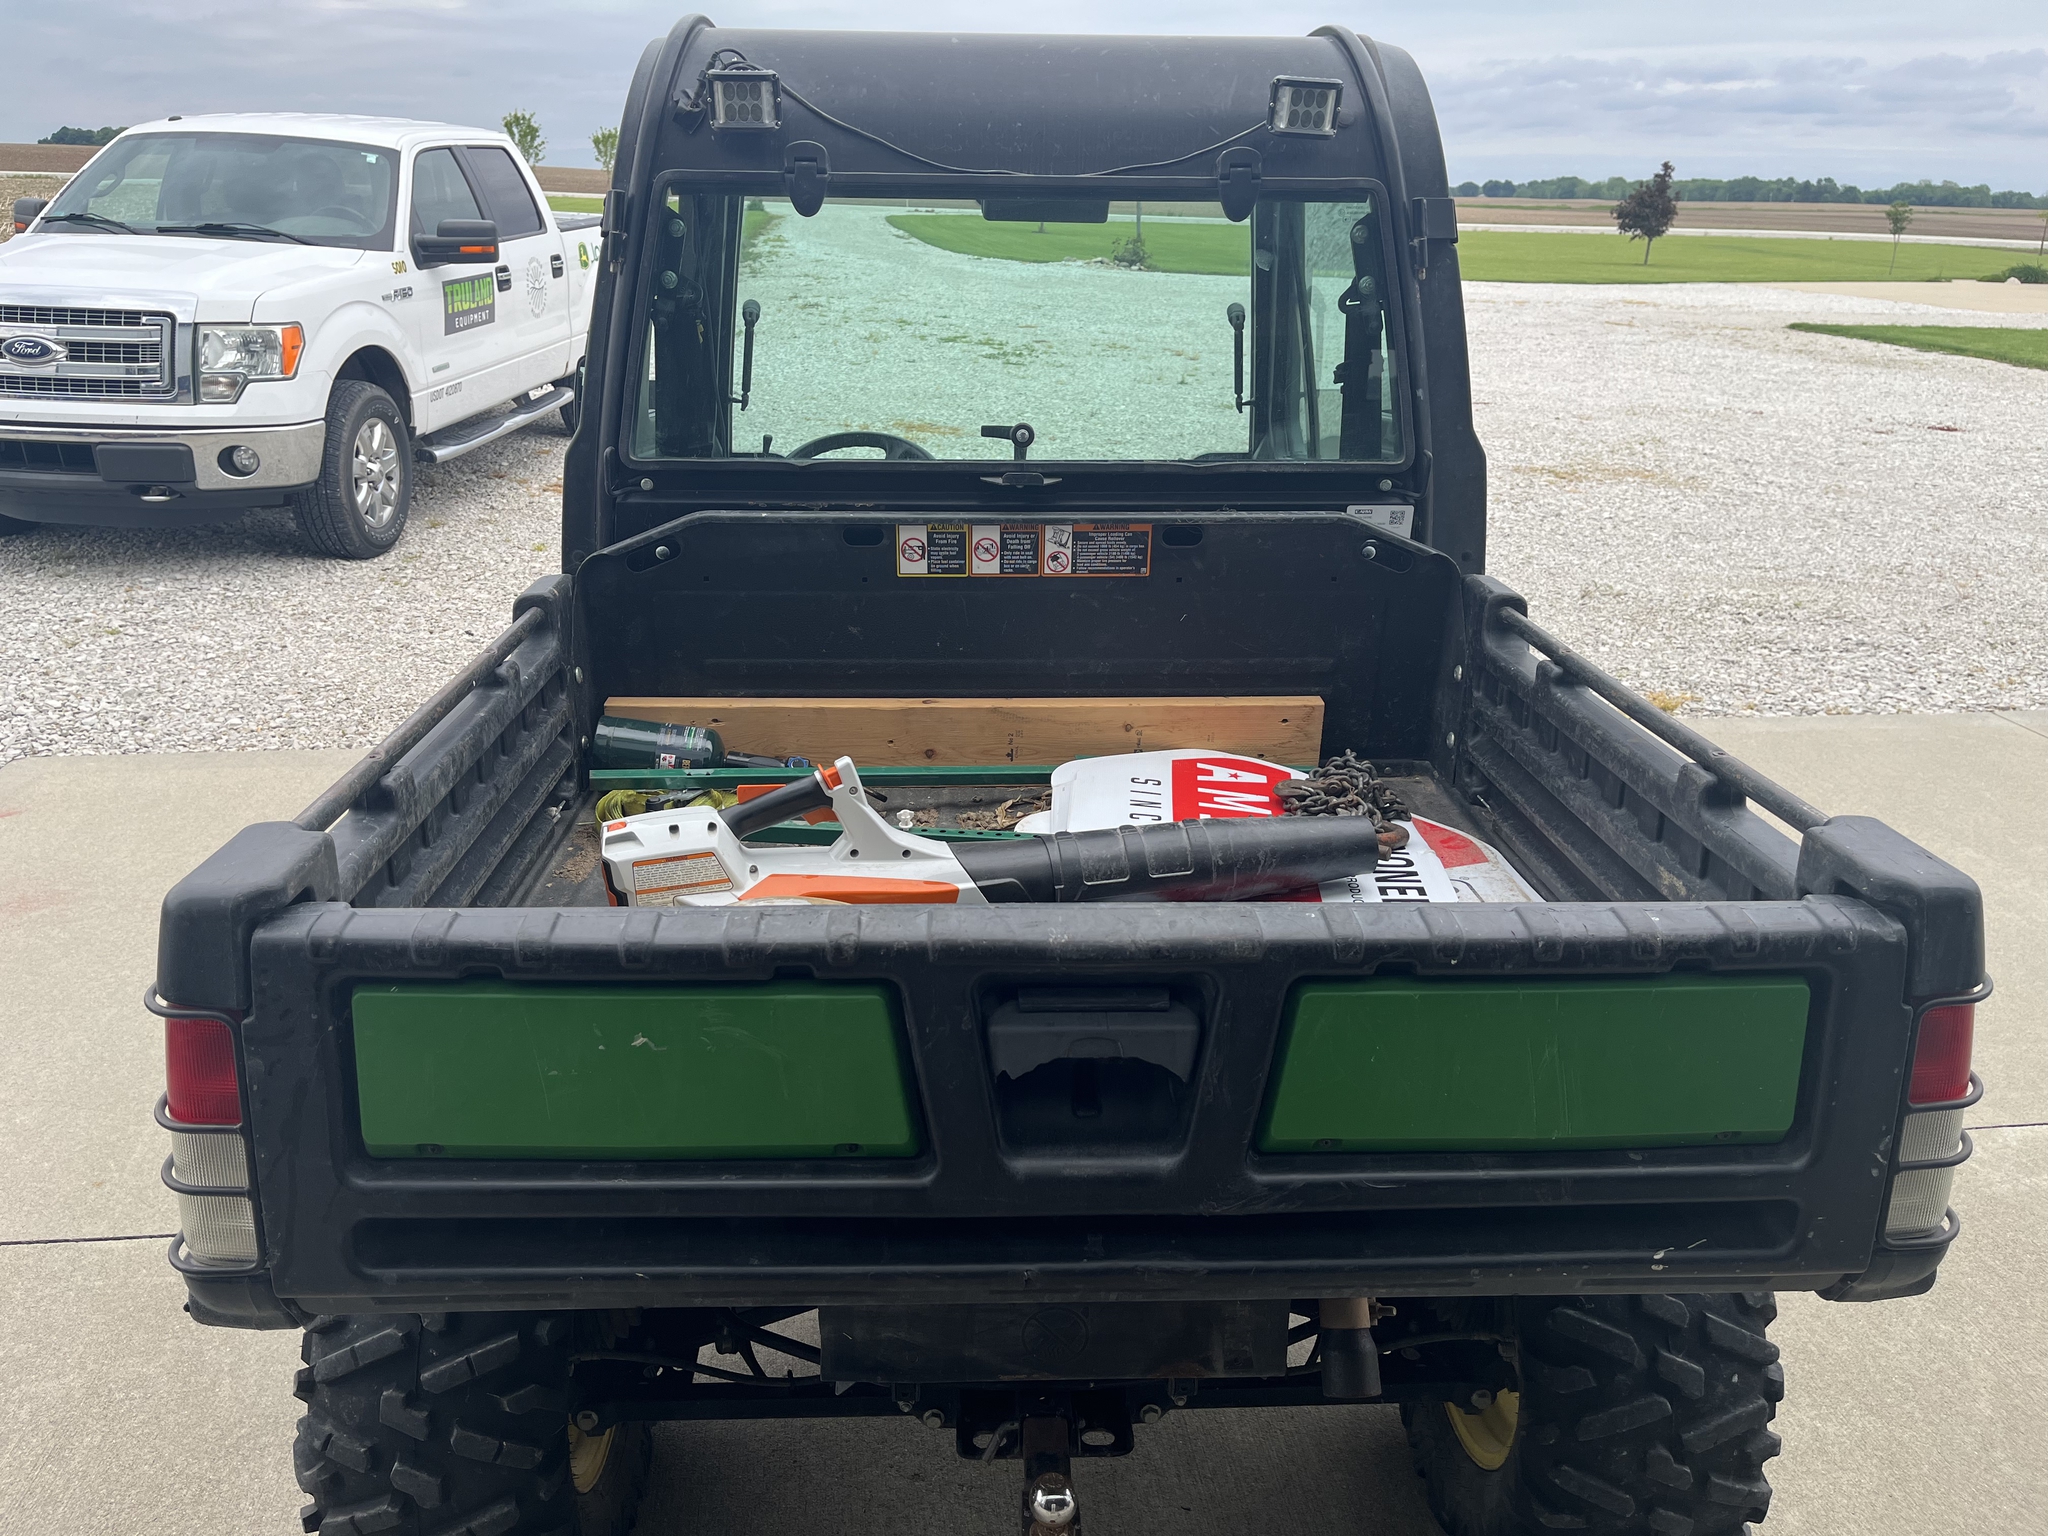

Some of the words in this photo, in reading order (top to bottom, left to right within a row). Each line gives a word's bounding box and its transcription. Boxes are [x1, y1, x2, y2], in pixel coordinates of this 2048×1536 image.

[590, 242, 600, 263] Jo
[445, 277, 492, 314] TRULAND
[455, 310, 489, 328] EQUIPMENT
[12, 341, 42, 355] Ford
[1196, 762, 1272, 819] AM
[1372, 846, 1431, 903] ONE
[1346, 875, 1365, 903] RODUC
